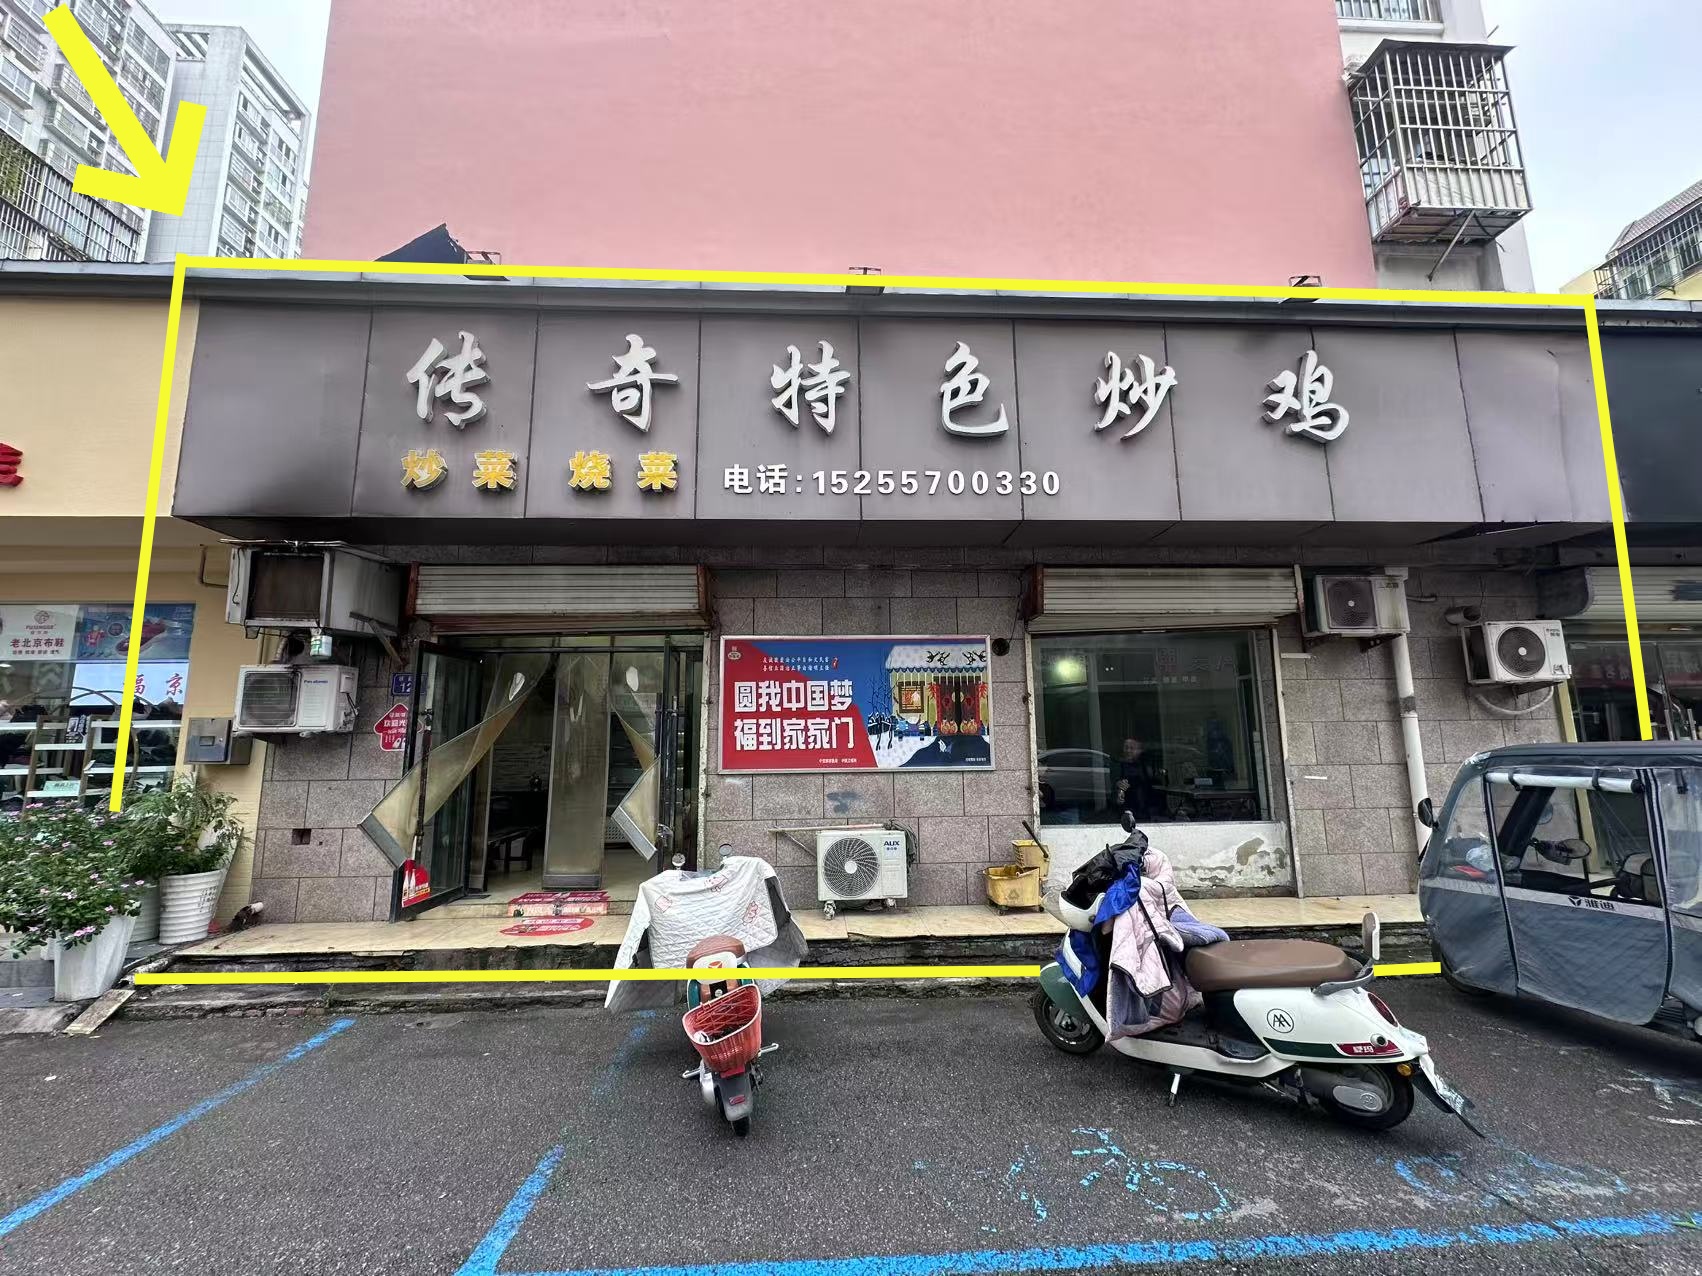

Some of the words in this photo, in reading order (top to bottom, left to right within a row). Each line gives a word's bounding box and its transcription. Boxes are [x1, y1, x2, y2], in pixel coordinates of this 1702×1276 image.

[405, 330, 1350, 443] 传奇特色炒鸡
[400, 449, 517, 491] 炒菜
[569, 450, 678, 493] 烧菜
[10, 637, 65, 648] 老北京布鞋
[734, 679, 853, 713] 圆我中国梦
[734, 717, 855, 751] 福到家家门
